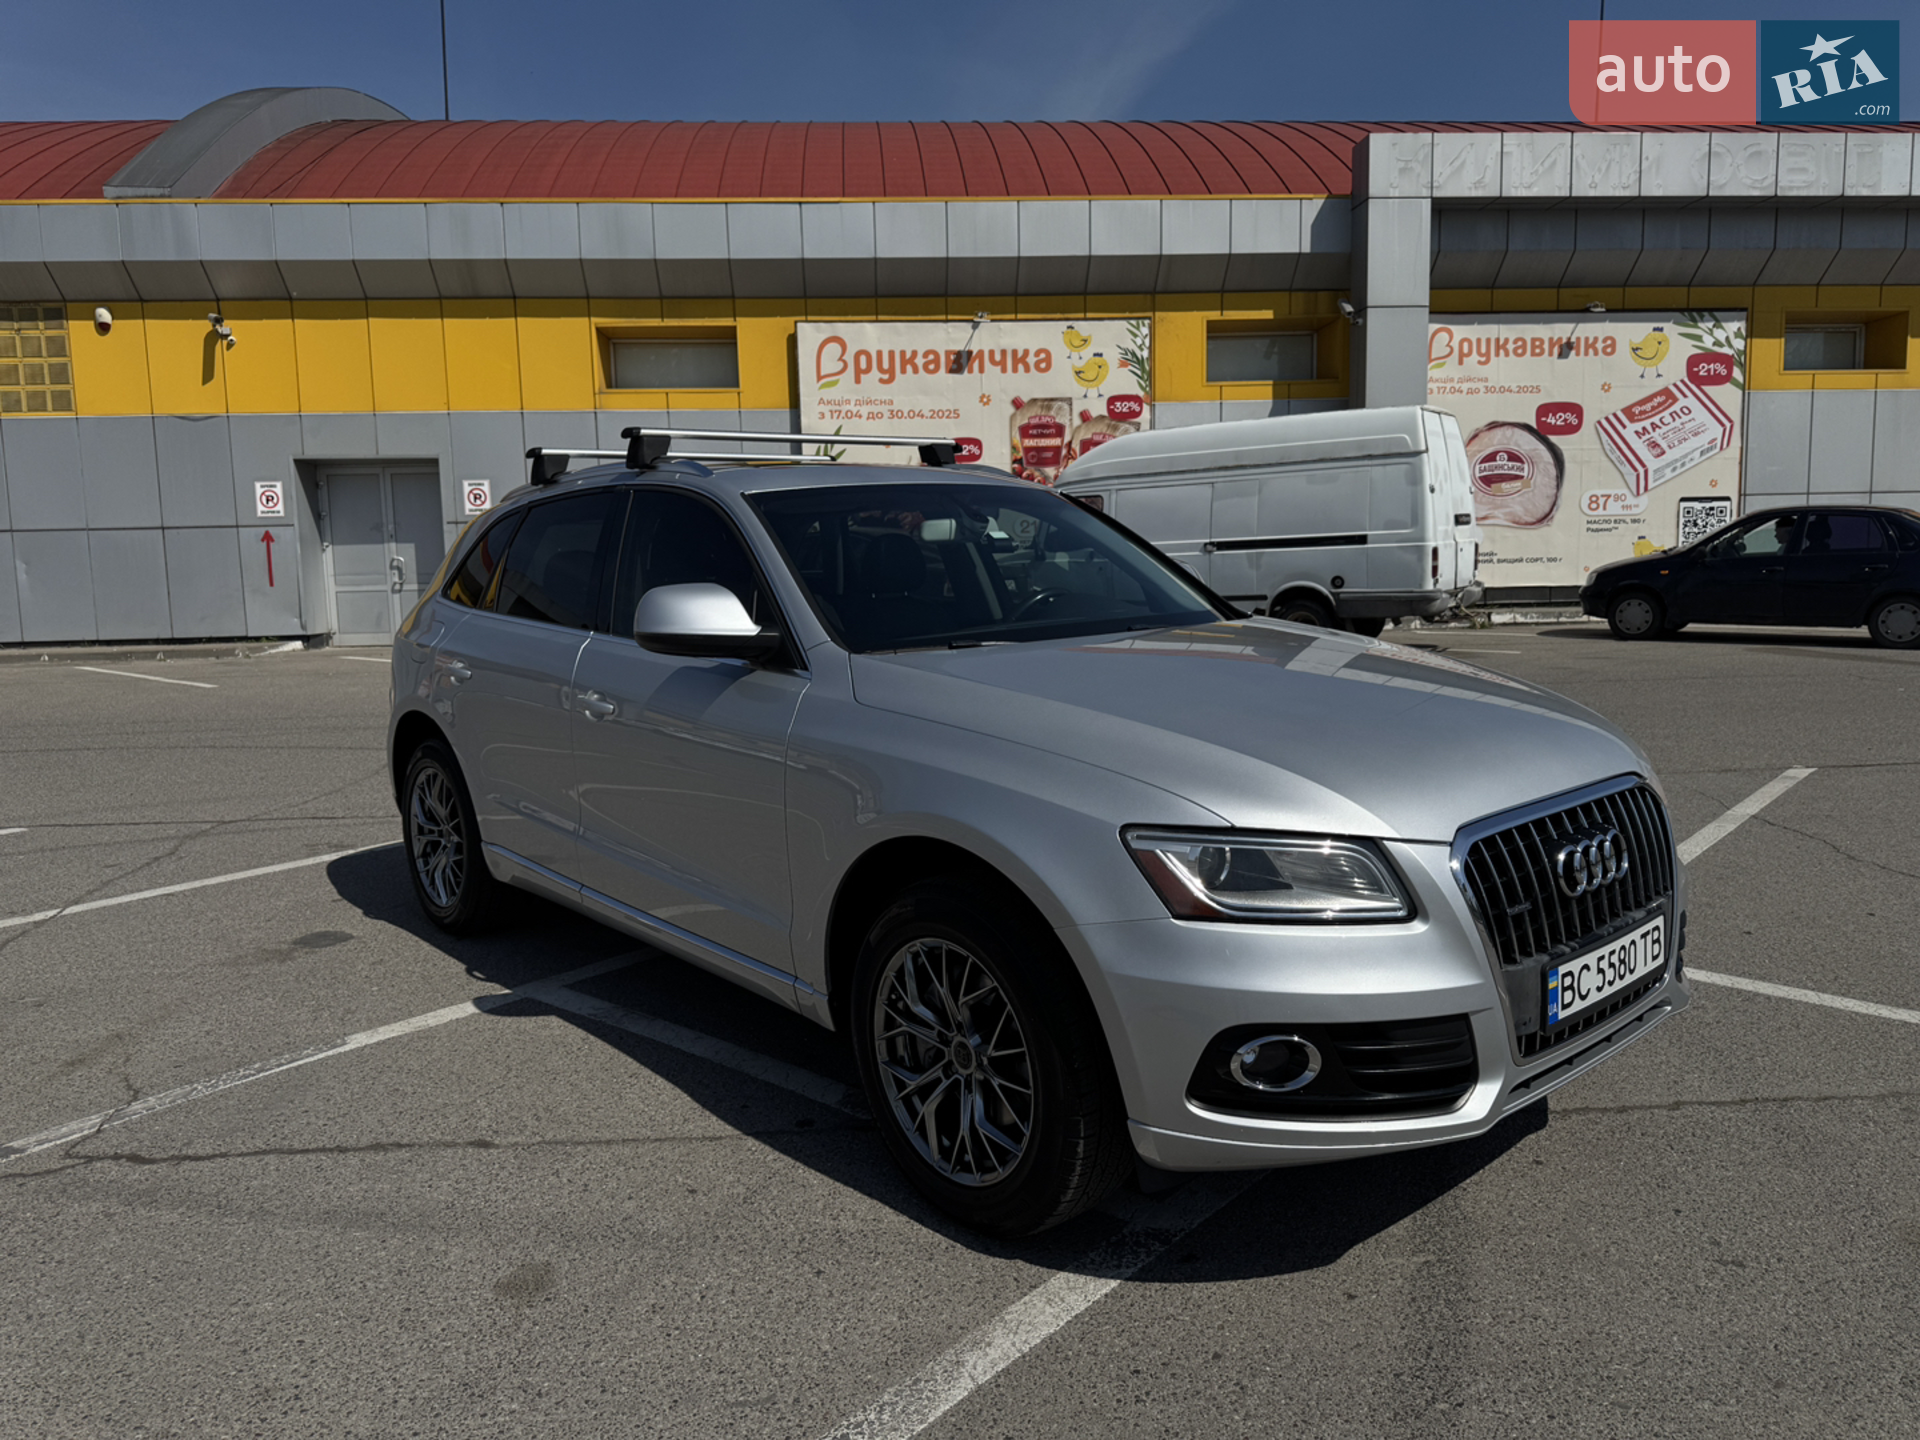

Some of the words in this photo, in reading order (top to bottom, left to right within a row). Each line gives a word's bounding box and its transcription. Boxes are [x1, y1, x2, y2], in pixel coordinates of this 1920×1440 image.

[1692, 362, 1728, 376] -21%
[1428, 375, 1455, 385] Акція
[1456, 375, 1489, 385] дійсна
[1436, 386, 1464, 395] 17.04
[1466, 387, 1481, 395] до
[1483, 385, 1542, 395] 30.04.2025
[817, 396, 852, 407] Акція
[854, 396, 894, 407] дійсна
[1109, 402, 1141, 413] -32%
[828, 409, 863, 420] 17.04
[866, 411, 884, 421] до
[887, 409, 961, 420] 30.04.2025
[1540, 412, 1578, 425] -42%
[1633, 405, 1693, 440] МАСЛО
[1561, 963, 1591, 1011] BC
[1595, 939, 1637, 993] 5580
[1640, 925, 1662, 968] TB
